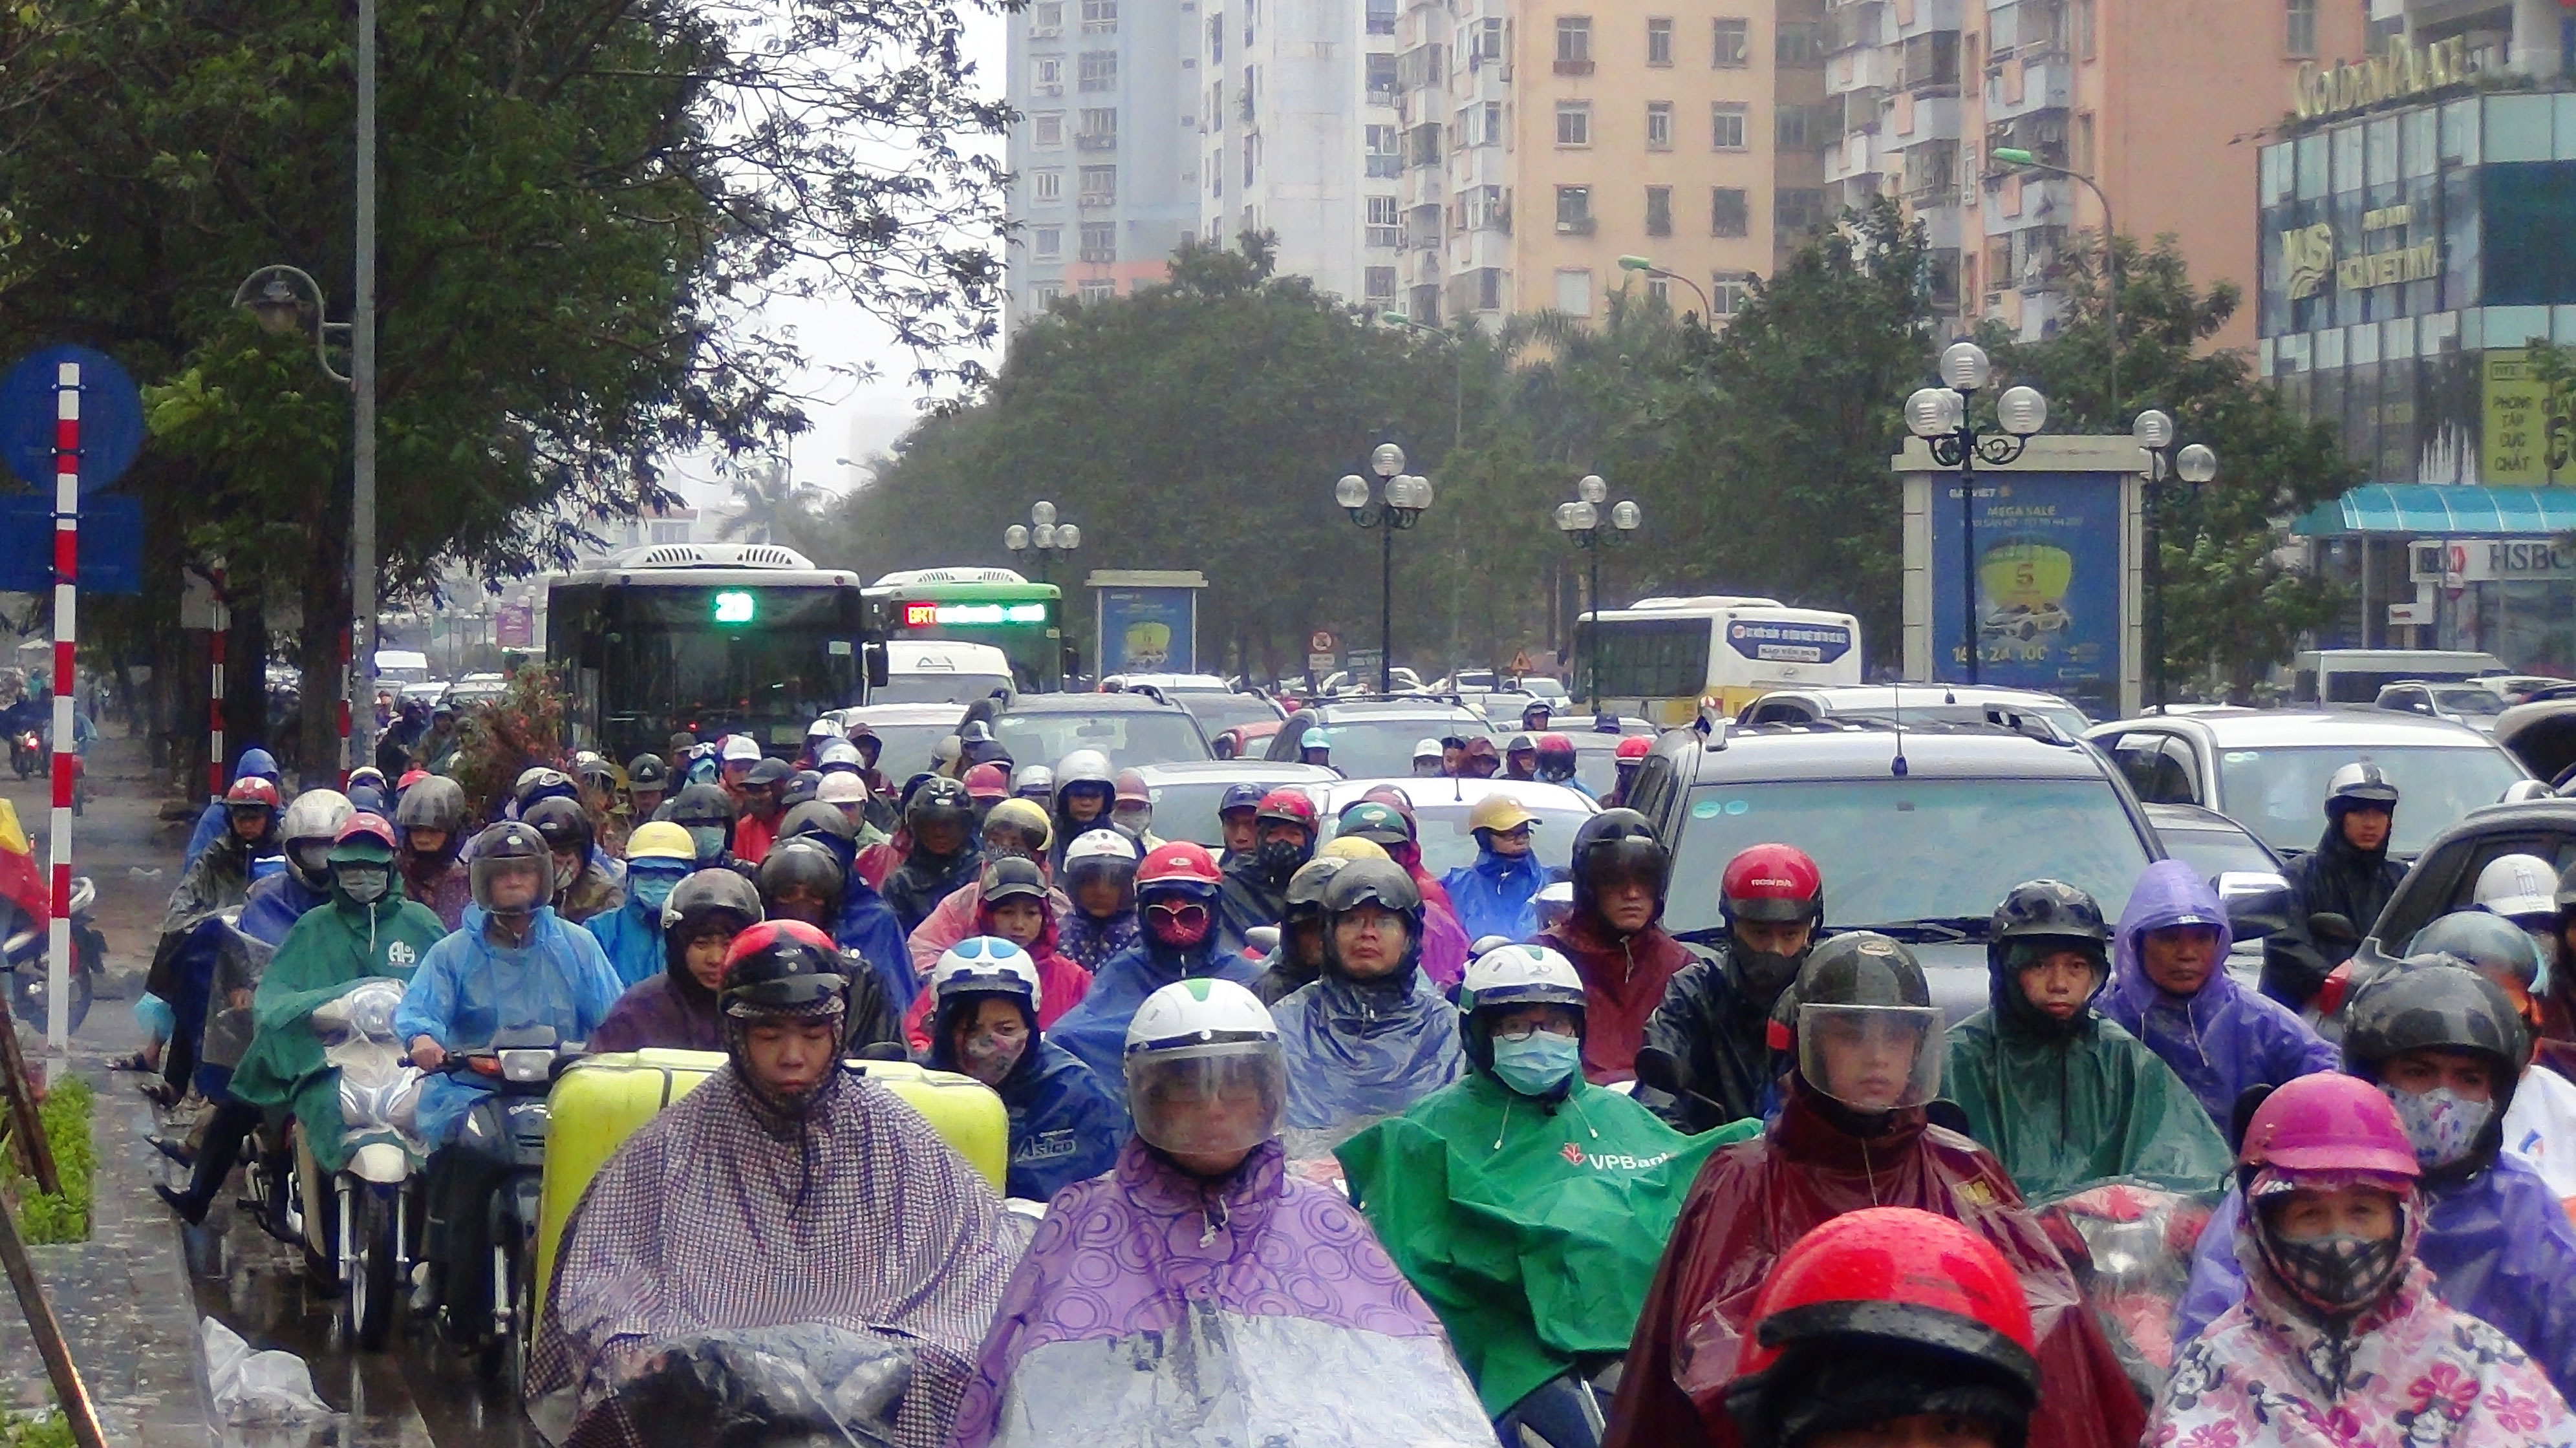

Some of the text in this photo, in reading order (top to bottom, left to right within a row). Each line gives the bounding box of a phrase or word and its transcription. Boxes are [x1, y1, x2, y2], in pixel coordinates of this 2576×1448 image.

[1949, 487, 1996, 498] BAVIET
[1988, 506, 2055, 516] MEGA SALE
[2488, 544, 2571, 571] HSBC
[908, 606, 935, 624] BRT
